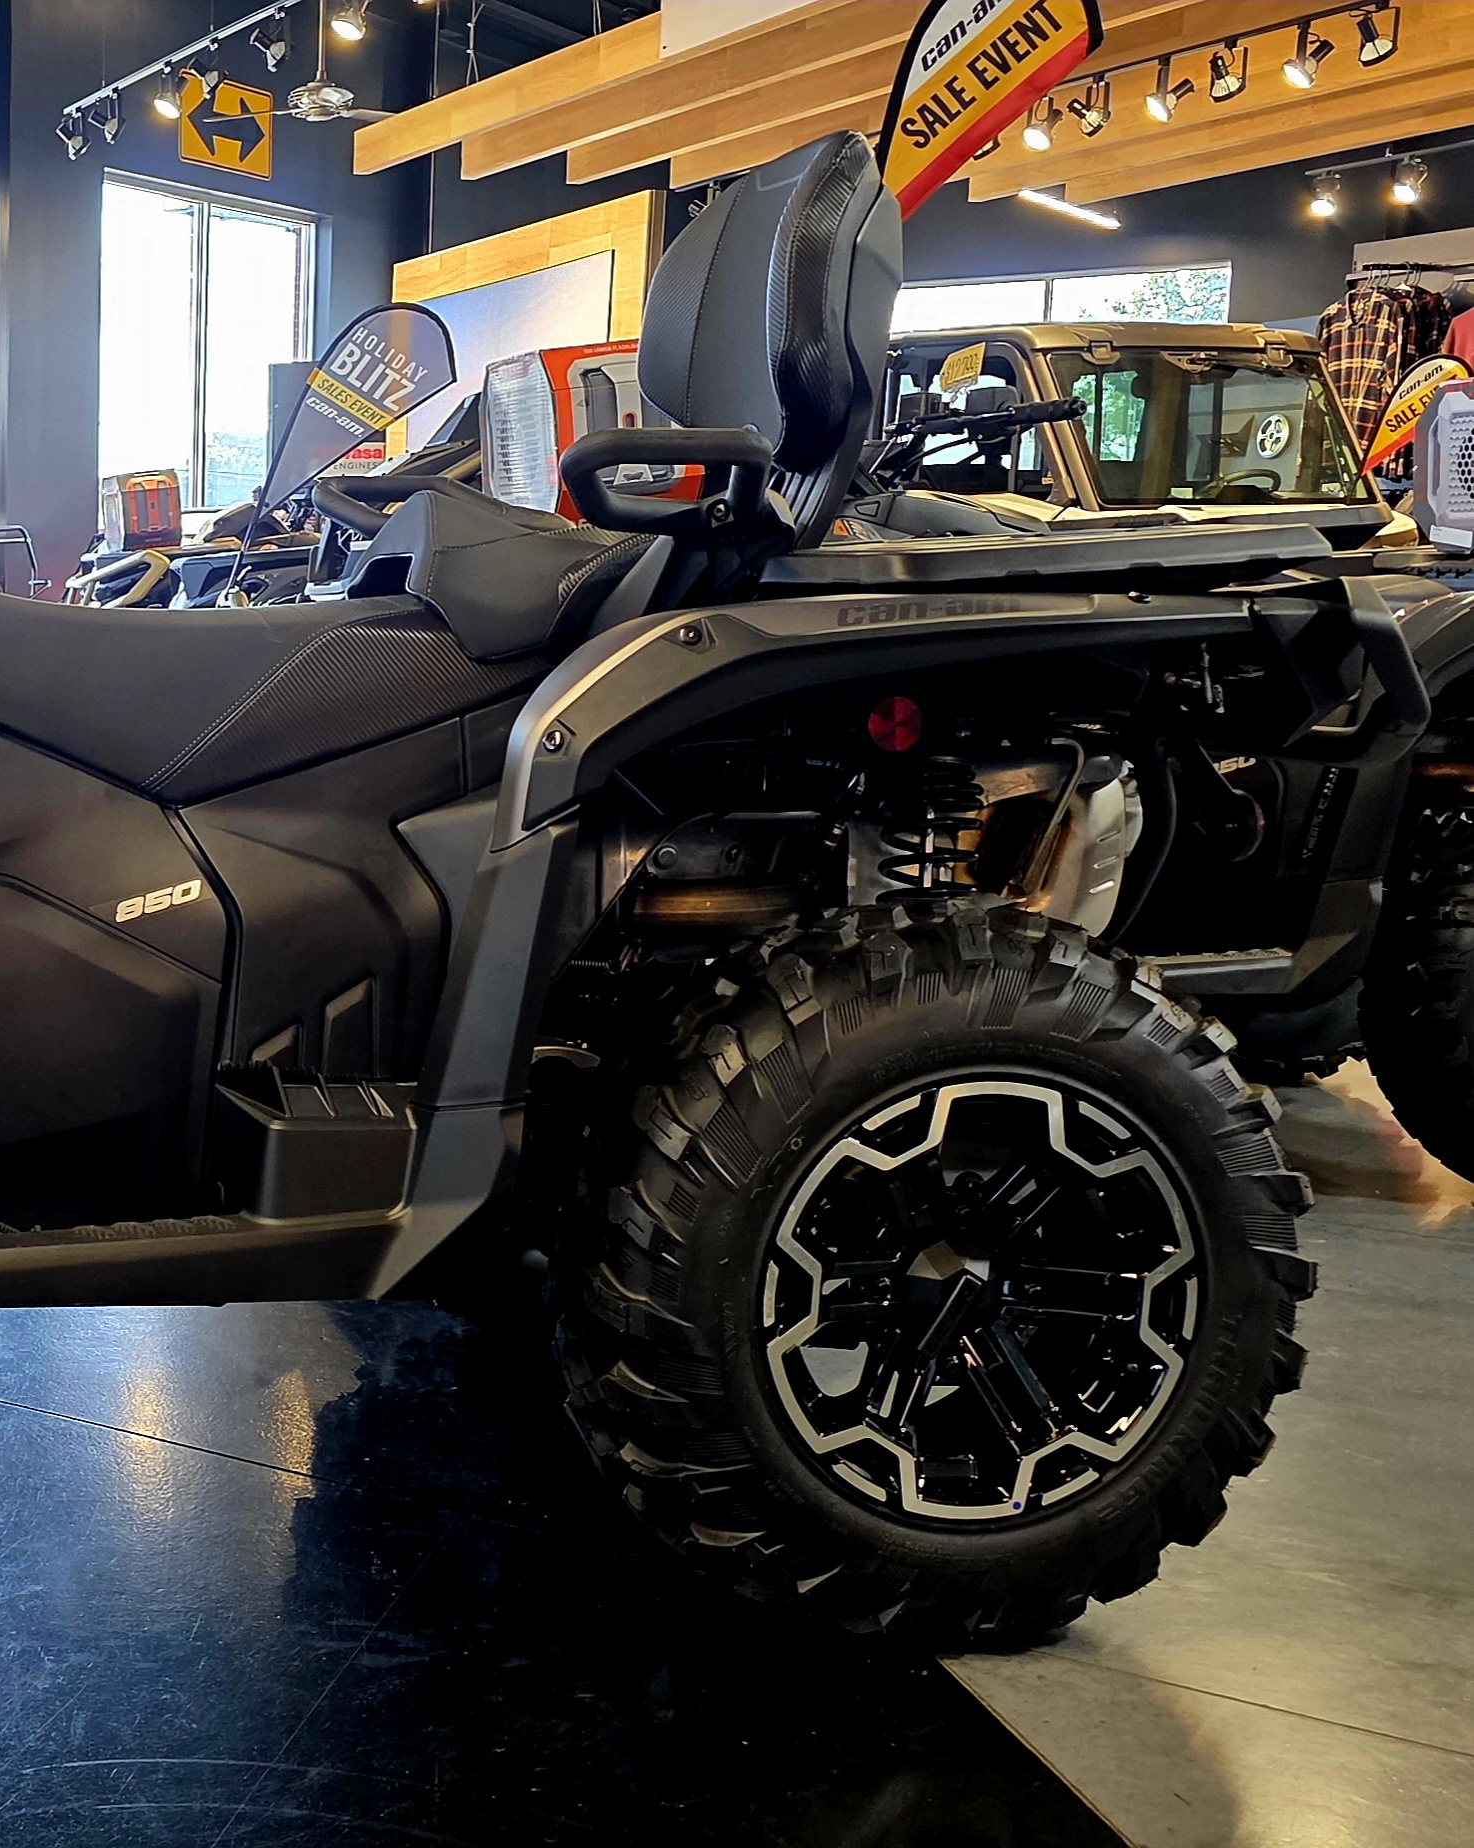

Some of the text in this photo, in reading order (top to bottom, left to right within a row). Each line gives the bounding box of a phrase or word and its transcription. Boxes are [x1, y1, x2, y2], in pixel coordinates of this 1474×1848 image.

[901, 0, 1063, 149] SALE EVENT
[330, 342, 416, 412] BLITZ
[352, 327, 428, 382] HOLIDAY
[317, 378, 386, 425] SALES EVENT
[1399, 364, 1443, 400] can-am
[1386, 402, 1422, 433] SALE
[837, 598, 1021, 627] can-am
[115, 879, 202, 923] 850
